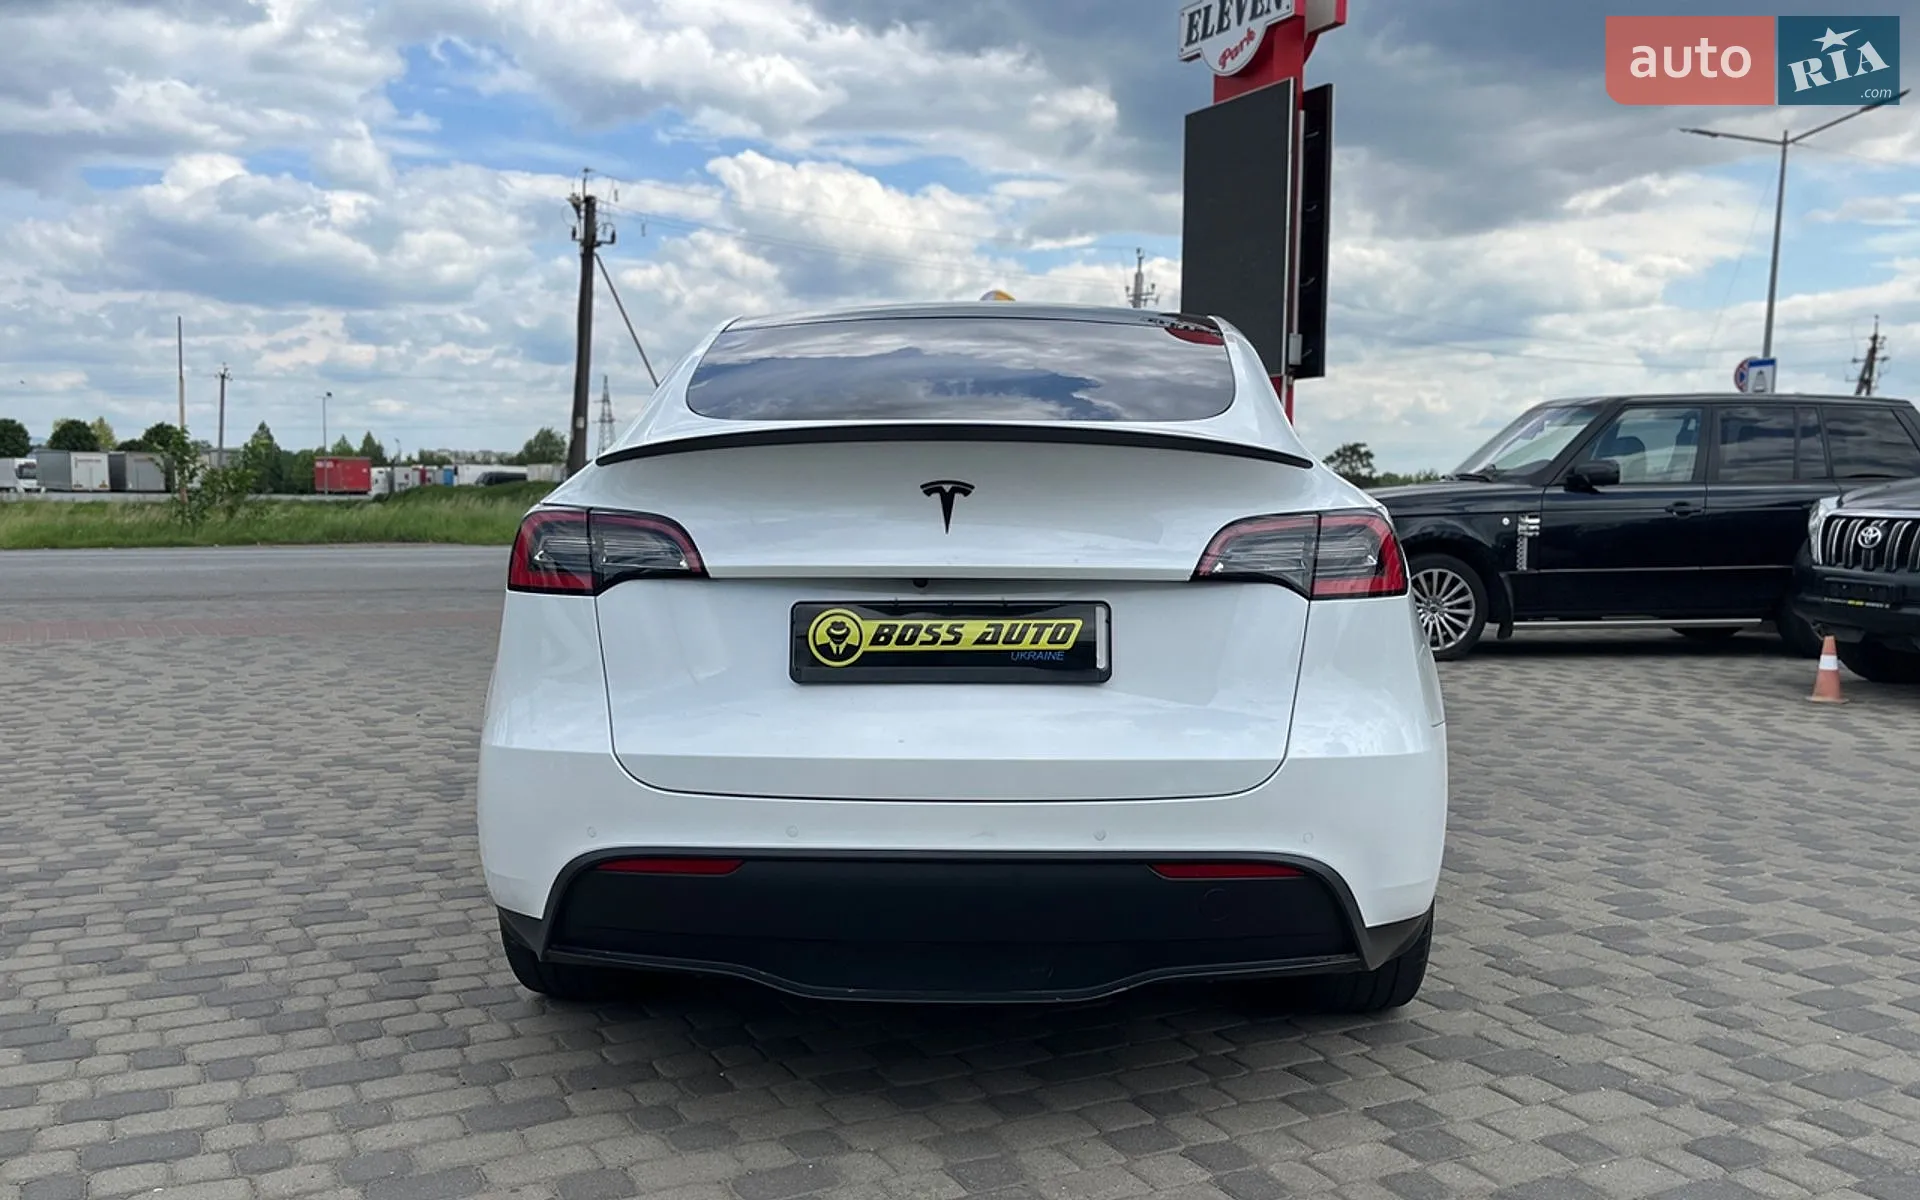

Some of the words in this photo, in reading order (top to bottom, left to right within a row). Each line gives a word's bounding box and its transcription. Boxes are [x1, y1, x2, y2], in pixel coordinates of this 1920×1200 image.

[1218, 26, 1256, 69] Park
[868, 622, 967, 646] BOSS
[972, 622, 1079, 645] AUTO
[1010, 651, 1065, 661] UKRAINE
